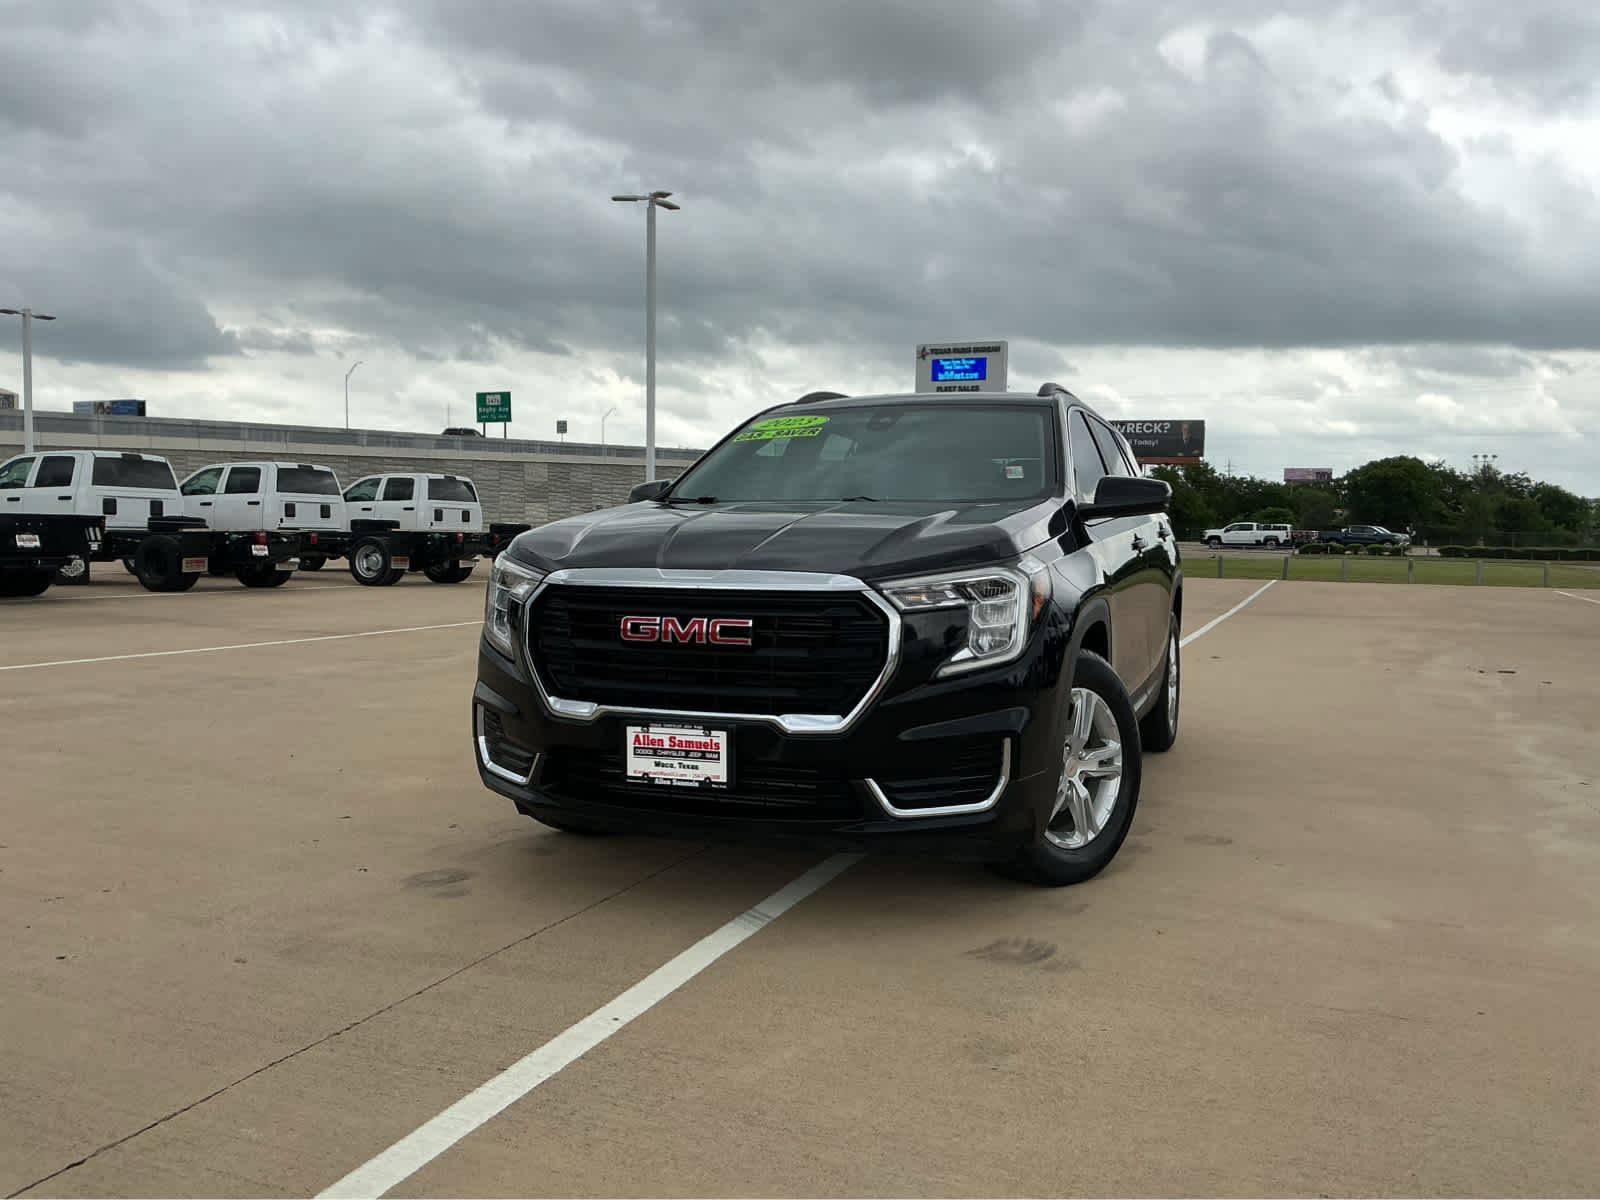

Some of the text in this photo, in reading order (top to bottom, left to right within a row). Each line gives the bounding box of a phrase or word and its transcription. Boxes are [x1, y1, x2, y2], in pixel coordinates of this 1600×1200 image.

[772, 427, 822, 437] SAVER
[620, 615, 753, 646] GMC
[633, 734, 721, 751] Allen Samuels
[656, 749, 686, 757] CHRYSLER
[654, 760, 700, 771] Waco, Texas
[654, 778, 671, 786] Allen
[672, 779, 700, 787] Samuels
